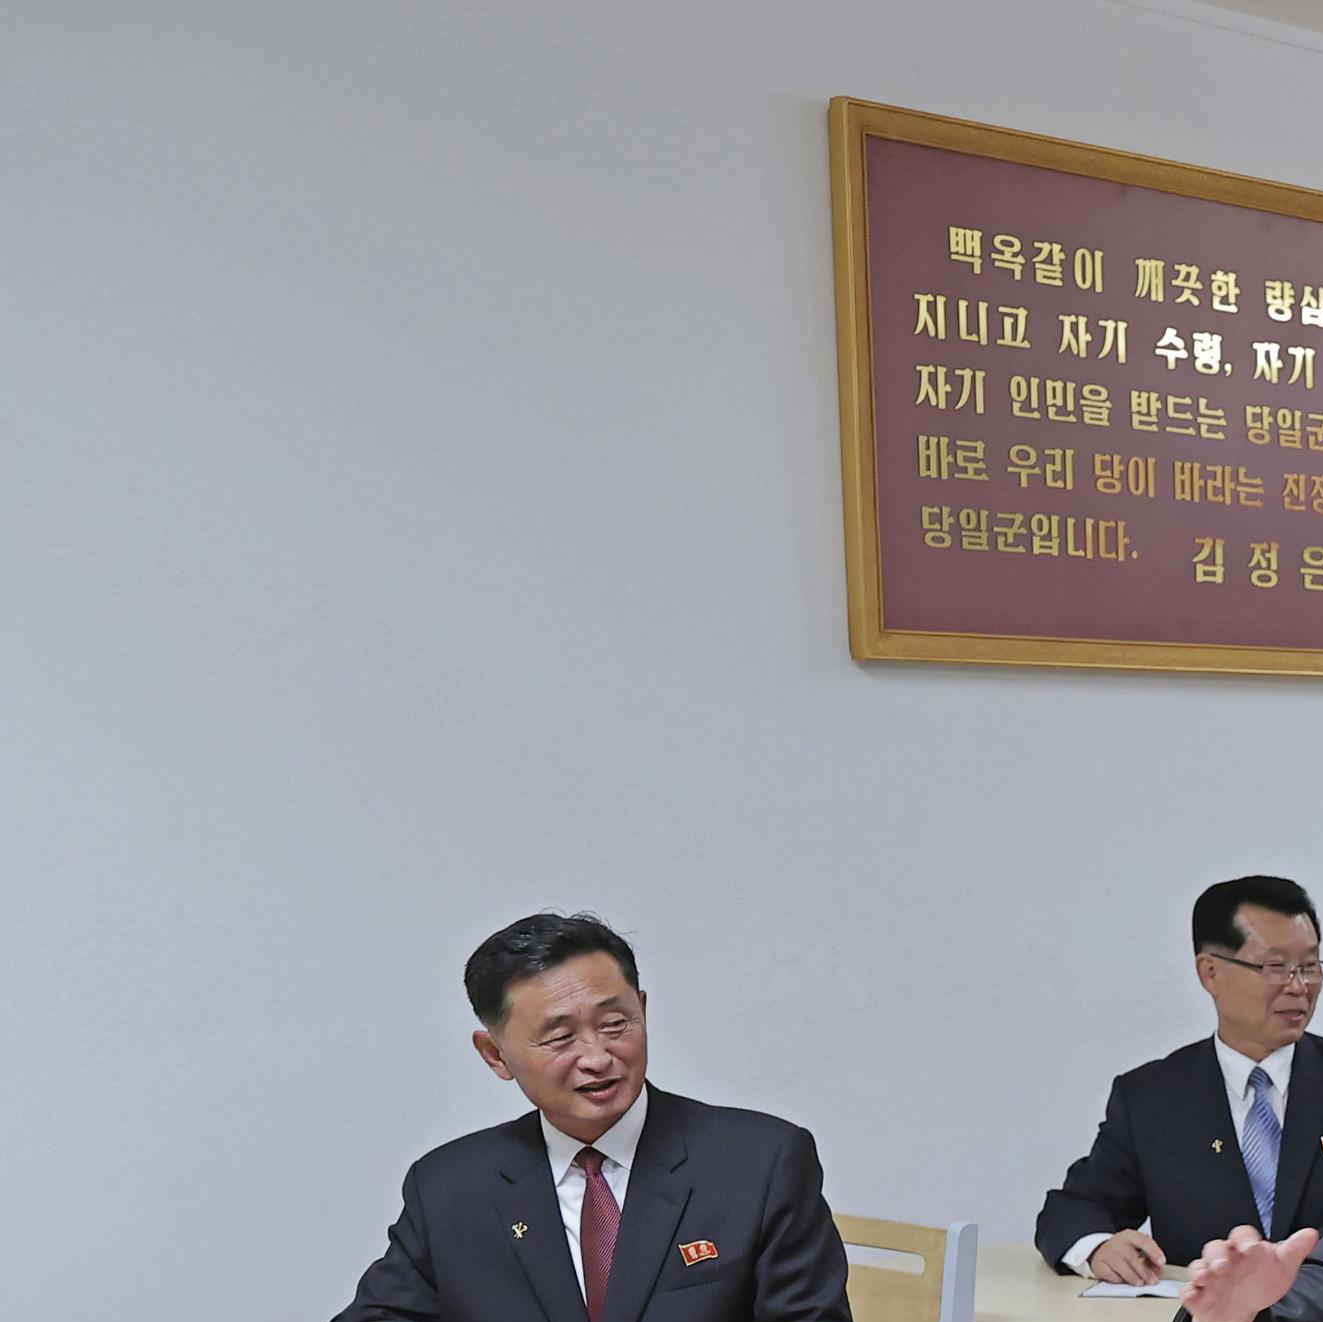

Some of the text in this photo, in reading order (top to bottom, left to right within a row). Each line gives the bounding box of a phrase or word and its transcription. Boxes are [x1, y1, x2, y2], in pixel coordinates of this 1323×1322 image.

[948, 226, 1104, 293] 백옥같이
[1134, 258, 1240, 314] 깨끗한
[913, 292, 1031, 349] 지니고
[1057, 312, 1128, 364] 자기
[1154, 327, 1233, 376] 수령,
[1251, 341, 1315, 389] 자기
[914, 364, 986, 414] 자기
[1008, 375, 1112, 429] 인민을
[1130, 390, 1227, 440] 받드는
[918, 435, 989, 483] 바로
[1007, 444, 1075, 490] 우리
[1094, 452, 1156, 498] 당이
[1173, 460, 1265, 508] 바라는
[921, 505, 1139, 563] 당일군입니다.
